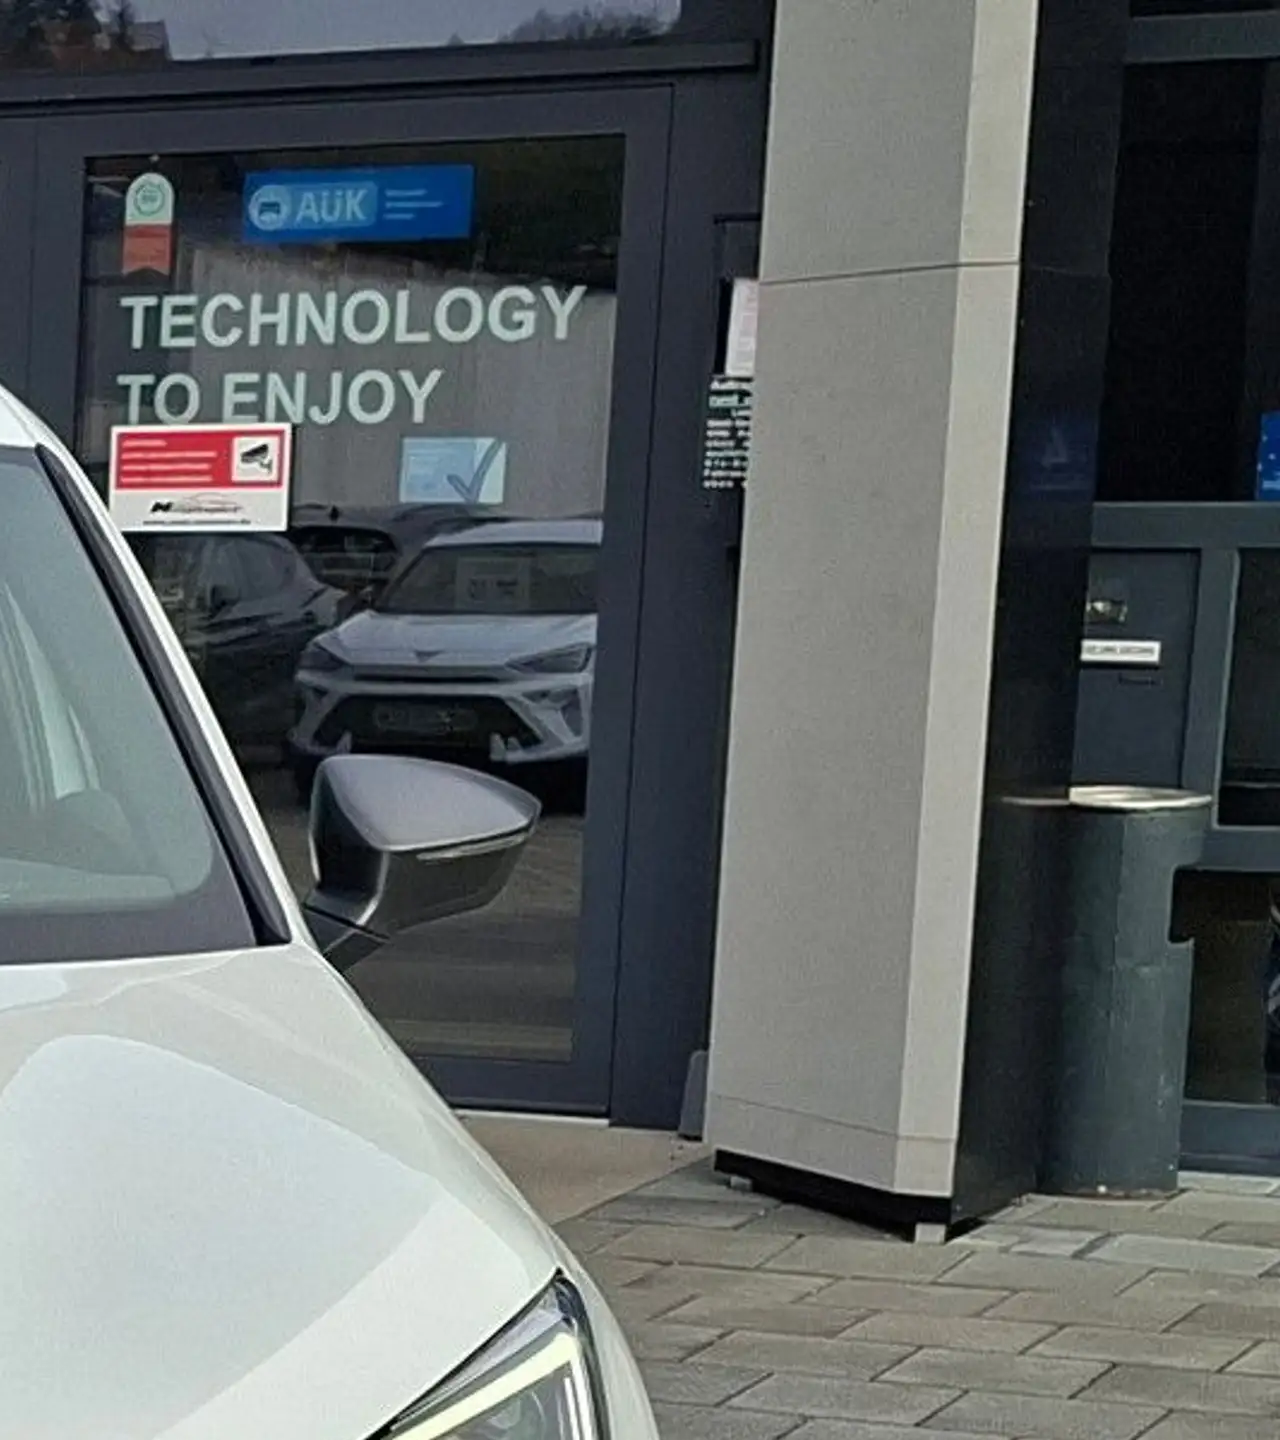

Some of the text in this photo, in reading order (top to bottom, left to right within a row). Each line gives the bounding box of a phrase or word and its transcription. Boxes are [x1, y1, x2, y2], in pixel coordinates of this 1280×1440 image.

[120, 285, 588, 350] TECHNOLOGY
[116, 368, 444, 425] TO ENJOY
